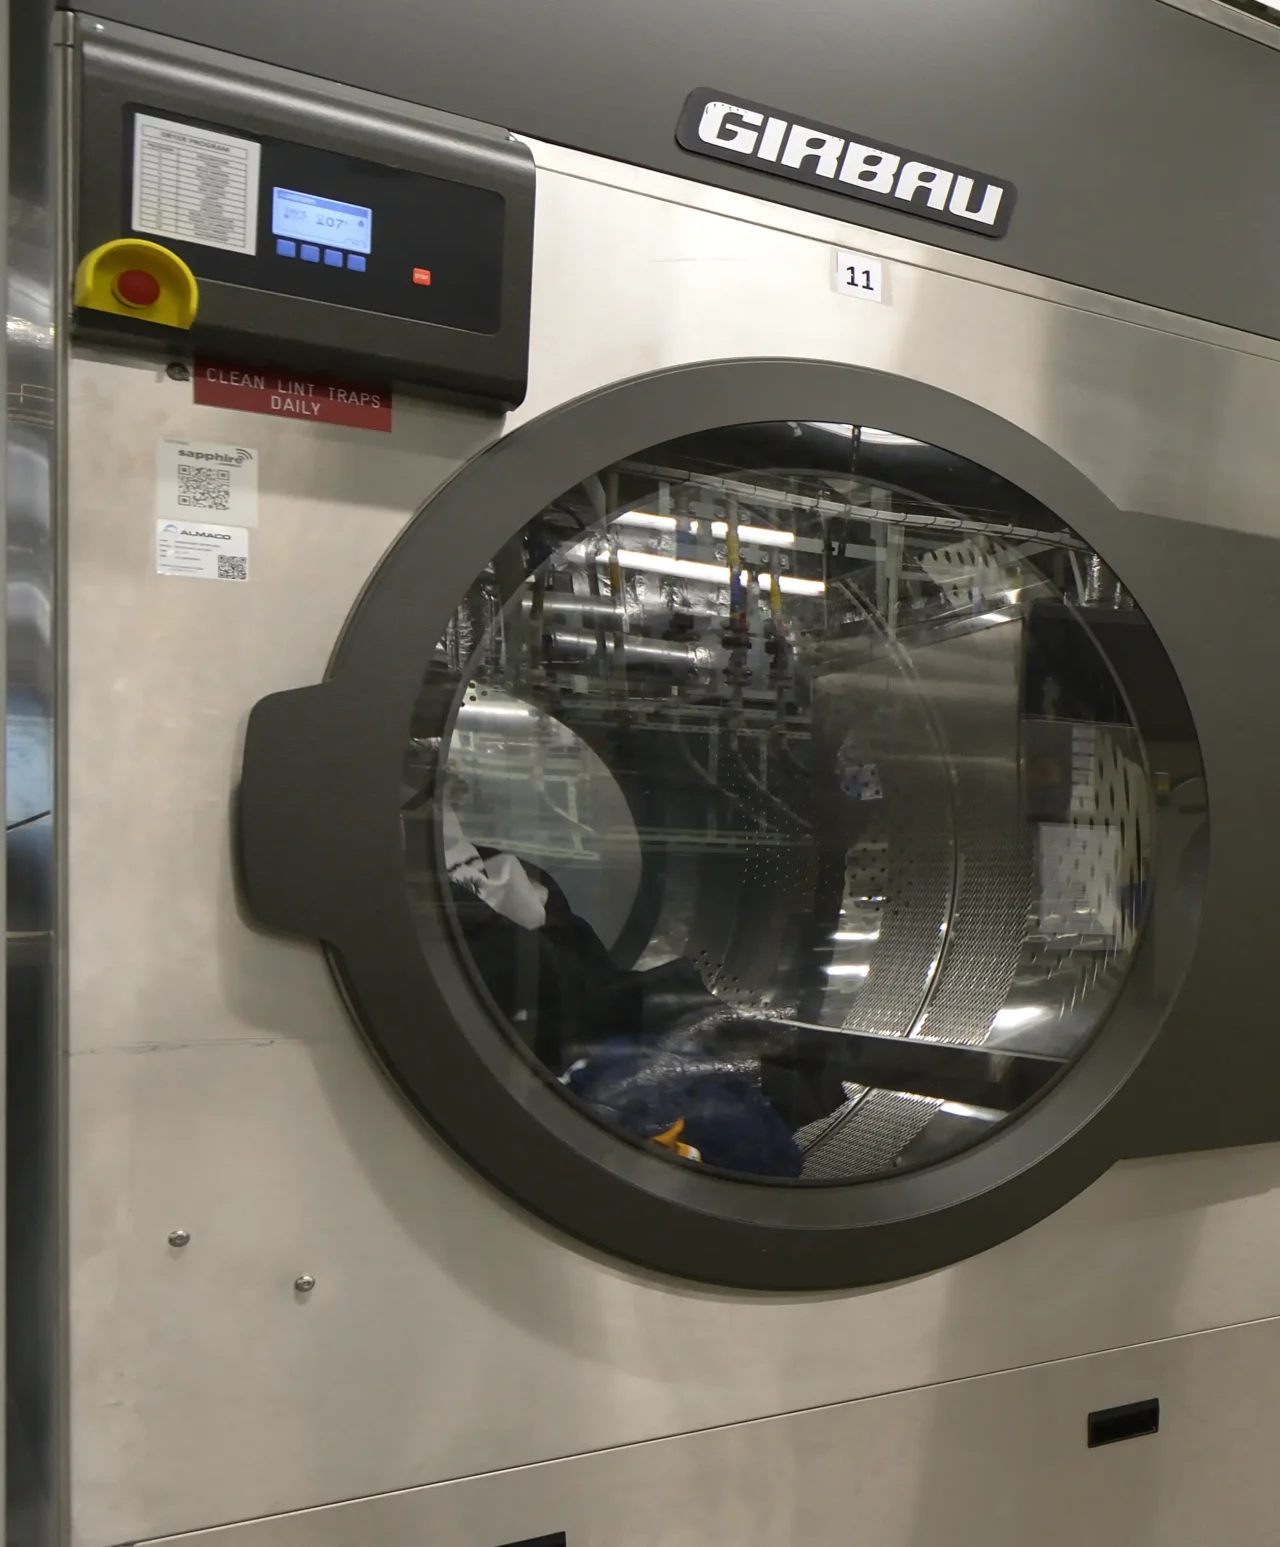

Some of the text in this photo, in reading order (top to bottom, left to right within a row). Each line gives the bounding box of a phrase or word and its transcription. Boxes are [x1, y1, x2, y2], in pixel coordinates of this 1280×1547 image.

[698, 101, 1003, 225] GIRBAU
[845, 266, 874, 291] 11
[206, 368, 381, 409] CLEAN LINT TRAPS
[271, 396, 321, 416] DAILY
[178, 449, 245, 464] sapphire
[180, 530, 231, 540] ALMACO
